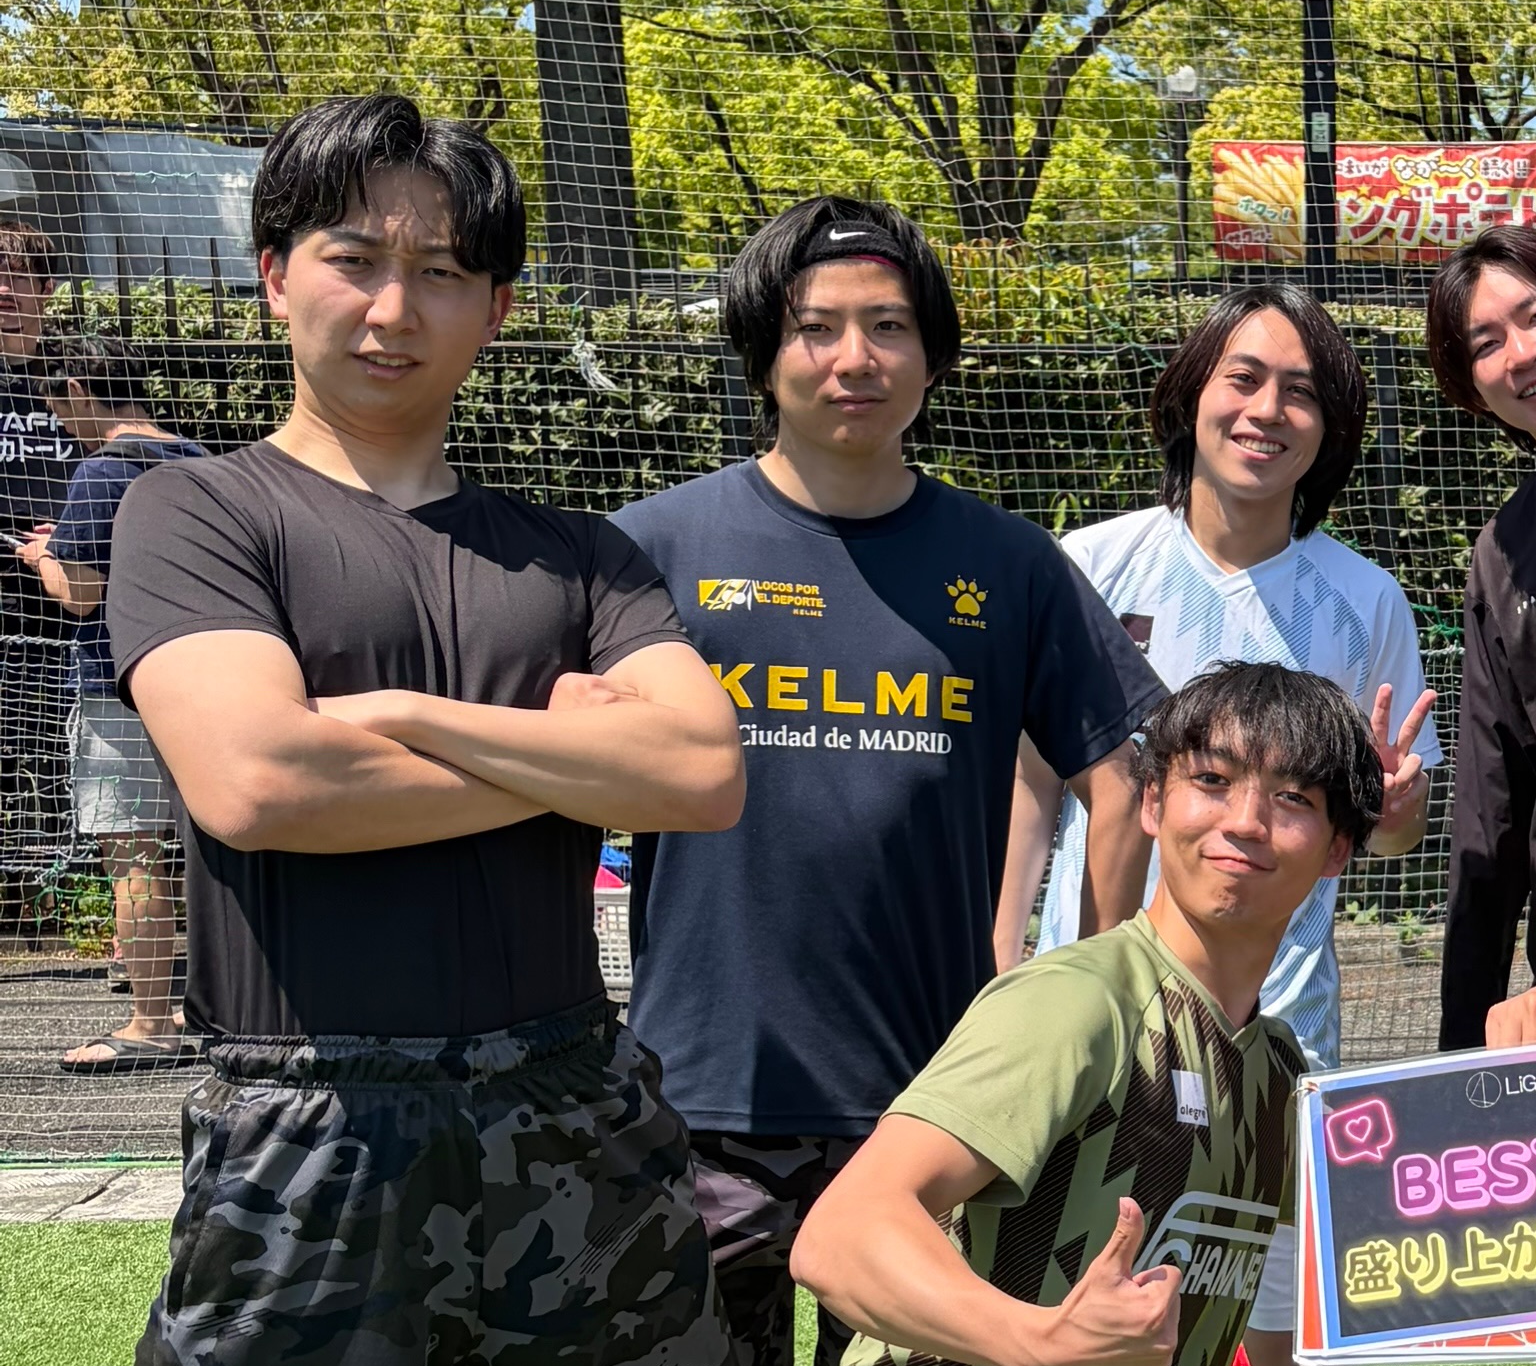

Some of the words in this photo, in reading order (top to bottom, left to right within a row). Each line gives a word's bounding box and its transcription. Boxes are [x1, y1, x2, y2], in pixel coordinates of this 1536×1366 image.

[0, 411, 64, 432] AFF
[755, 579, 794, 593] LOCOS
[796, 583, 820, 595] POR
[756, 592, 771, 604] EL
[792, 607, 824, 617] KELME
[948, 615, 988, 630] KELME
[709, 662, 975, 723] KELME
[737, 723, 817, 748] Ciudad
[824, 727, 852, 750] de
[858, 729, 953, 755] MADRID
